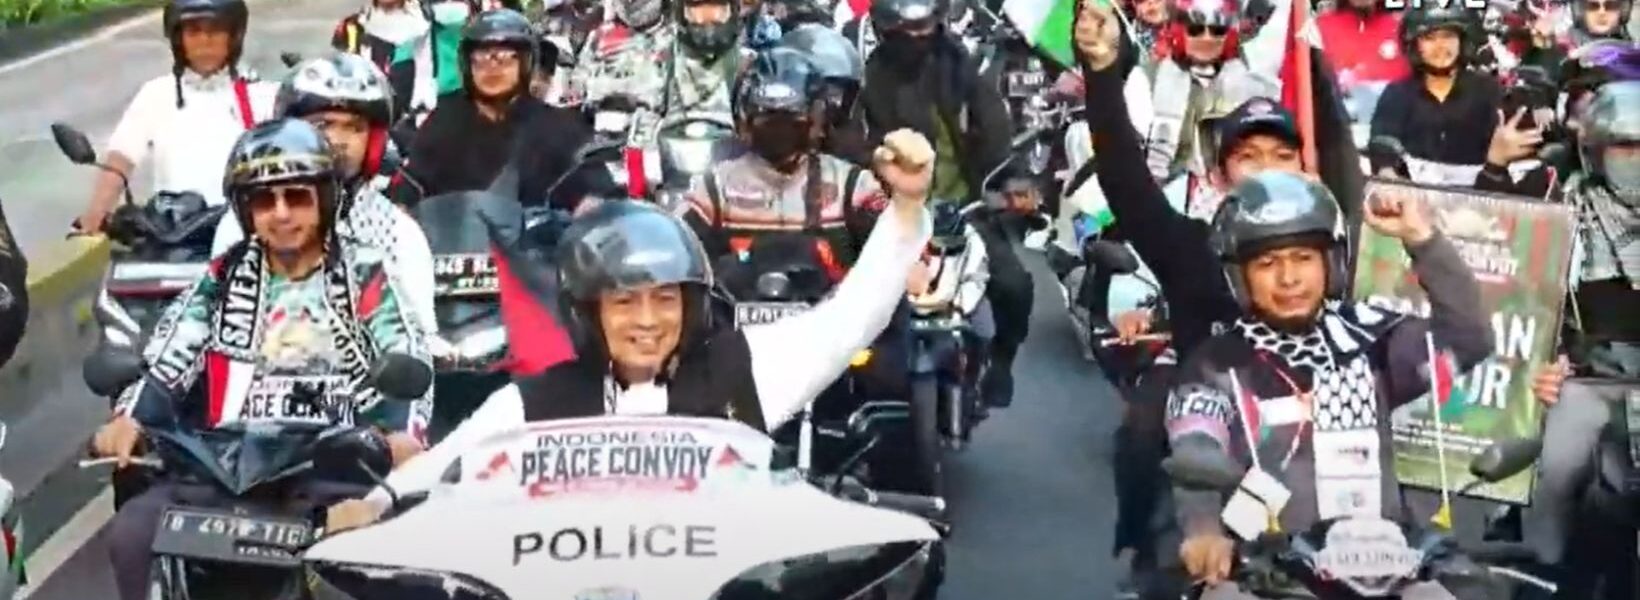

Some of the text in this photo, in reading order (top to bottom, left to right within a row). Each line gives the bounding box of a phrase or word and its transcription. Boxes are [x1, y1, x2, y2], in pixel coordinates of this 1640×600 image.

[536, 431, 698, 448] INDONESIA
[519, 446, 714, 486] PEACE CONVOY
[511, 524, 718, 566] POLICE
